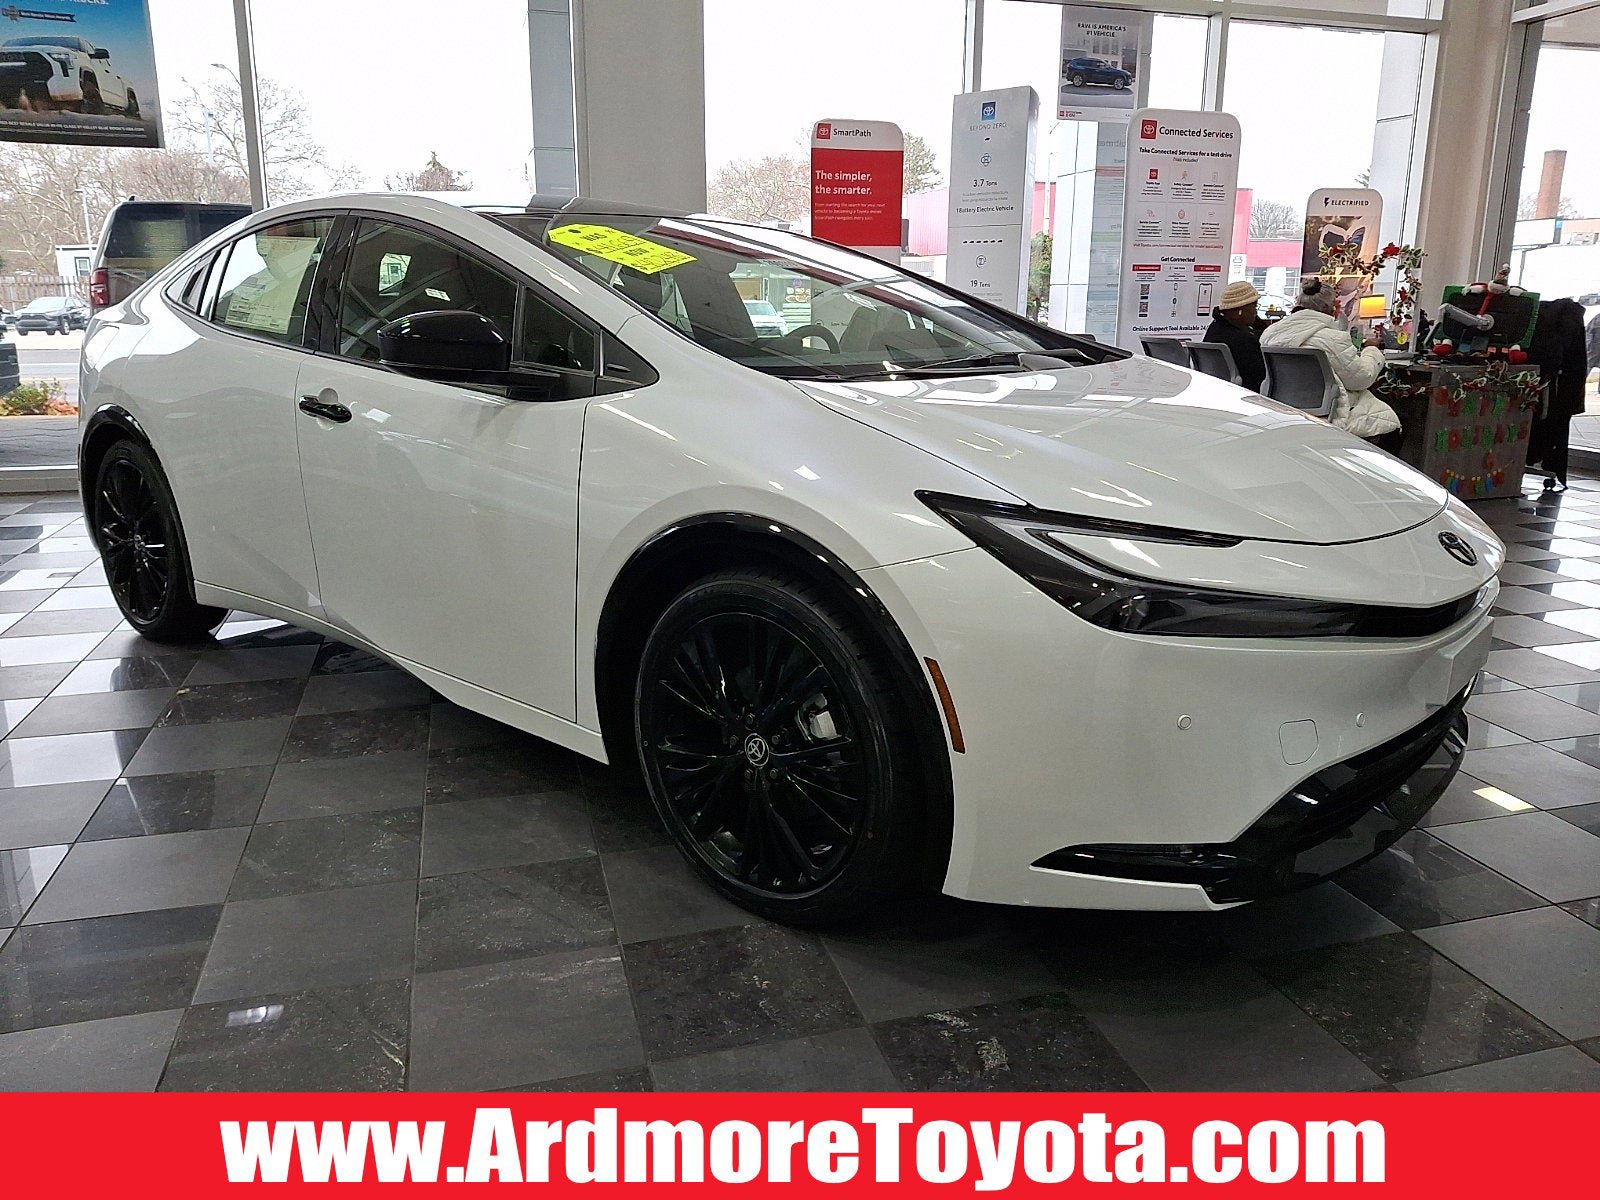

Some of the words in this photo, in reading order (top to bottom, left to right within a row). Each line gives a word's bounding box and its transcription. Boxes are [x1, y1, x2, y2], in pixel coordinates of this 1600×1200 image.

[1098, 24, 1127, 32] AMERICA'S
[833, 128, 872, 137] SmartPath
[1159, 126, 1201, 137] Connected
[1203, 129, 1233, 139] Services
[815, 170, 833, 180] The
[834, 171, 872, 182] simpler,
[973, 179, 985, 187] 3.7
[815, 184, 831, 194] the
[833, 186, 872, 195] smarter.
